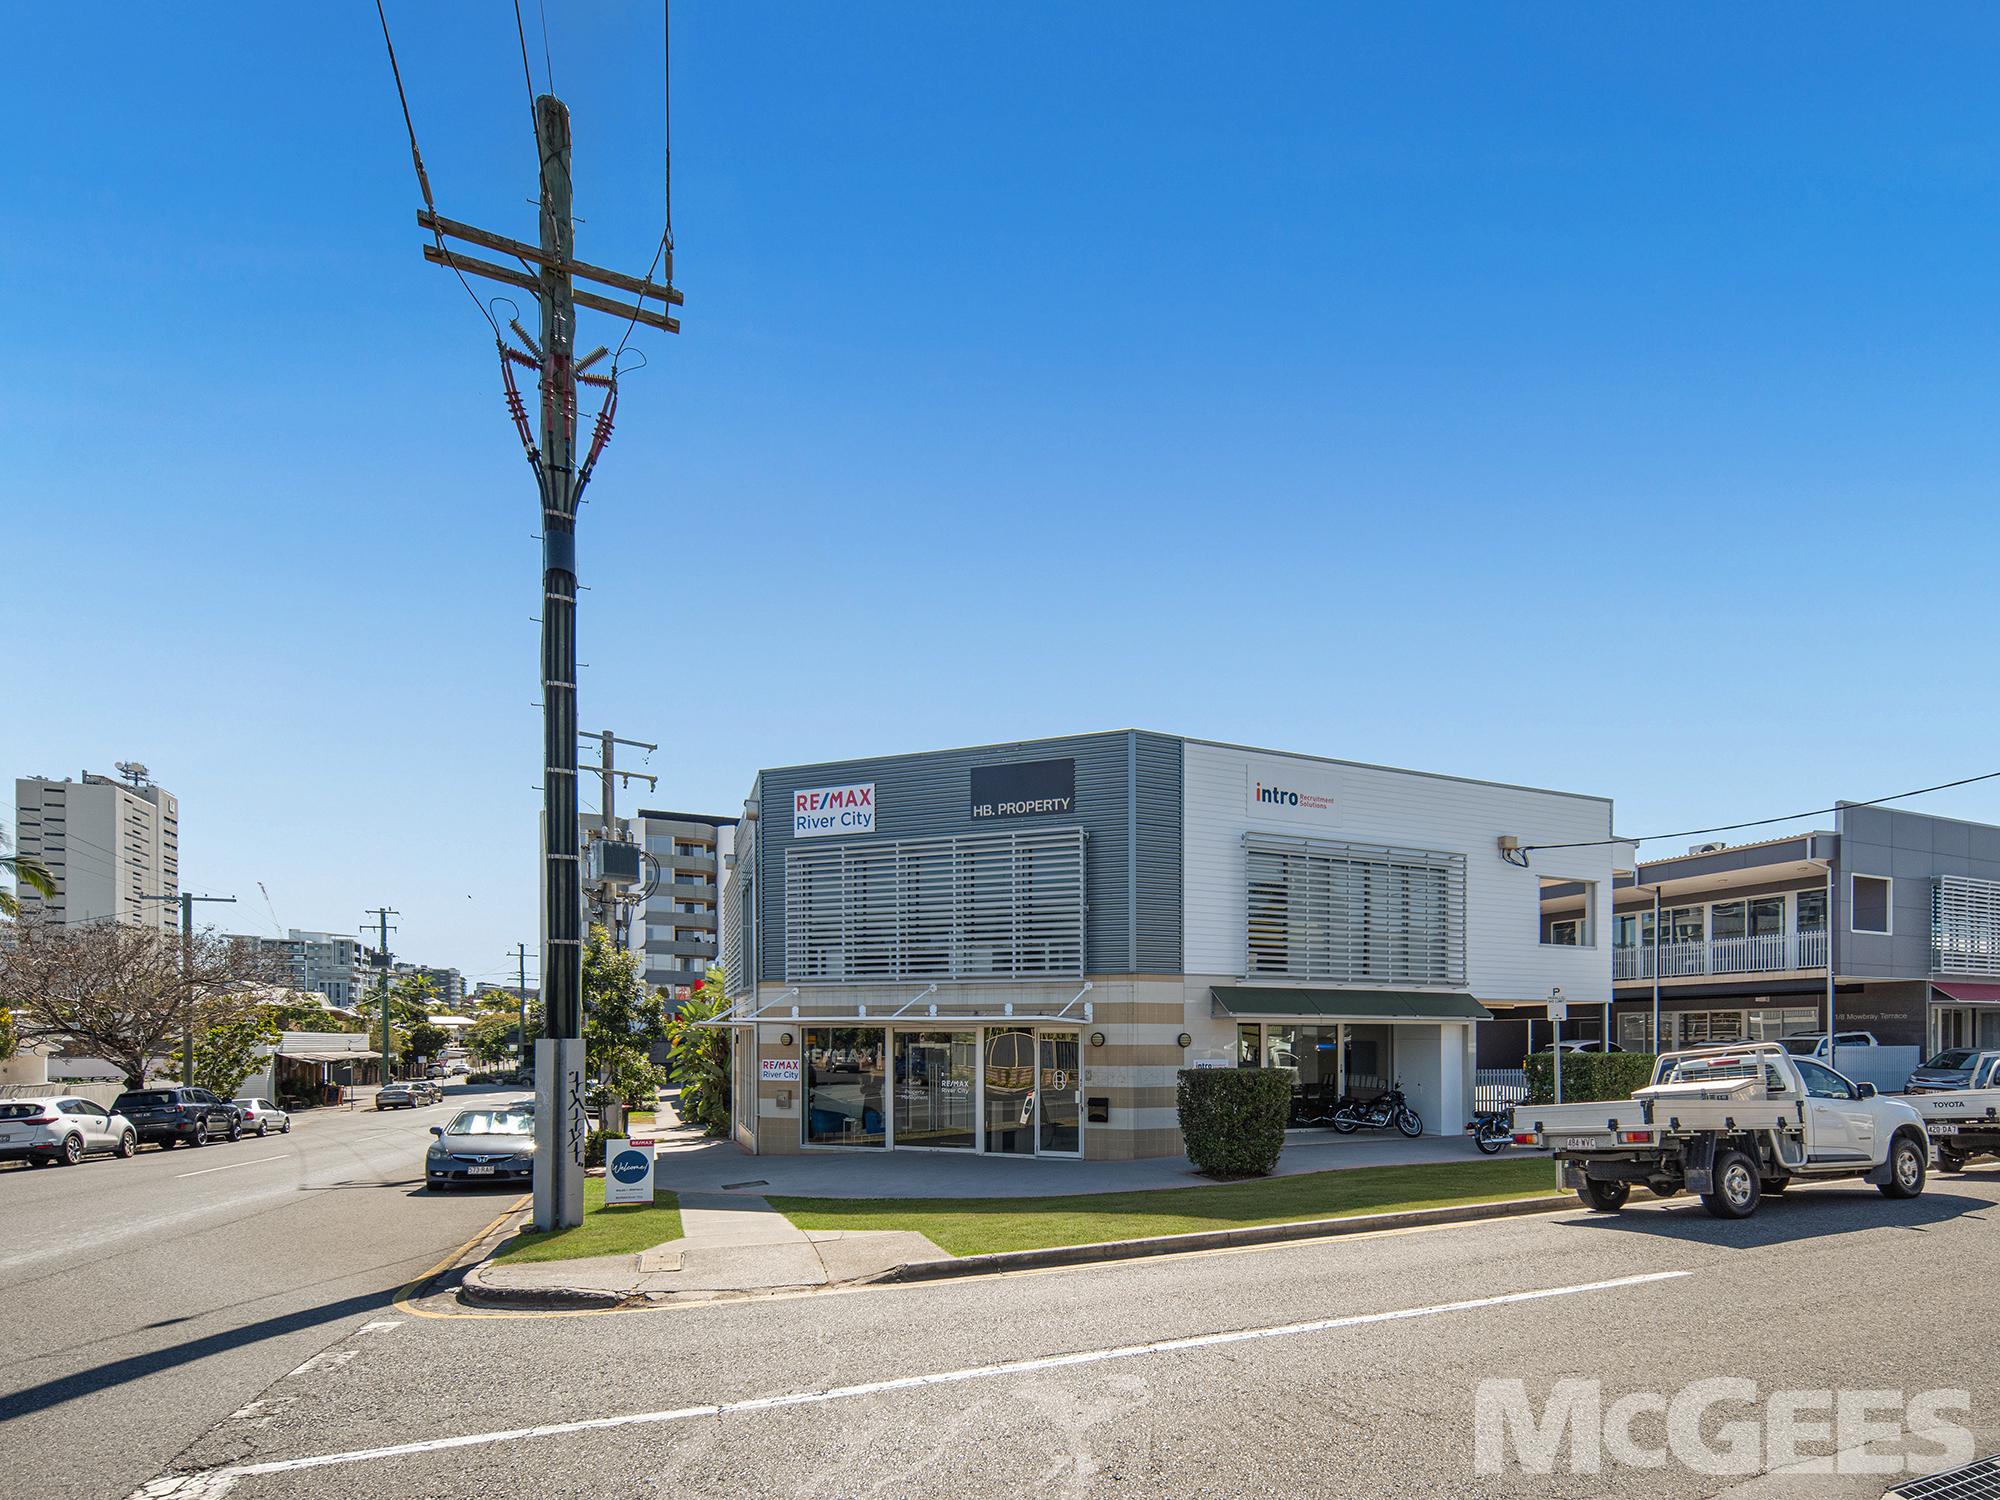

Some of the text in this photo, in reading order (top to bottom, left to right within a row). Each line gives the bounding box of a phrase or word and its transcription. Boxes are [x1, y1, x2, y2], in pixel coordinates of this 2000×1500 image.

[1256, 782, 1298, 806] intro
[1299, 794, 1335, 804] Recruitment
[796, 788, 872, 811] RE/MAX
[1299, 800, 1328, 809] Solutions
[973, 797, 1070, 817] HB. PROPERTY
[796, 811, 872, 830] River City
[1552, 987, 1561, 996] P
[762, 1061, 799, 1070] RE/MAX
[783, 1071, 799, 1079] City
